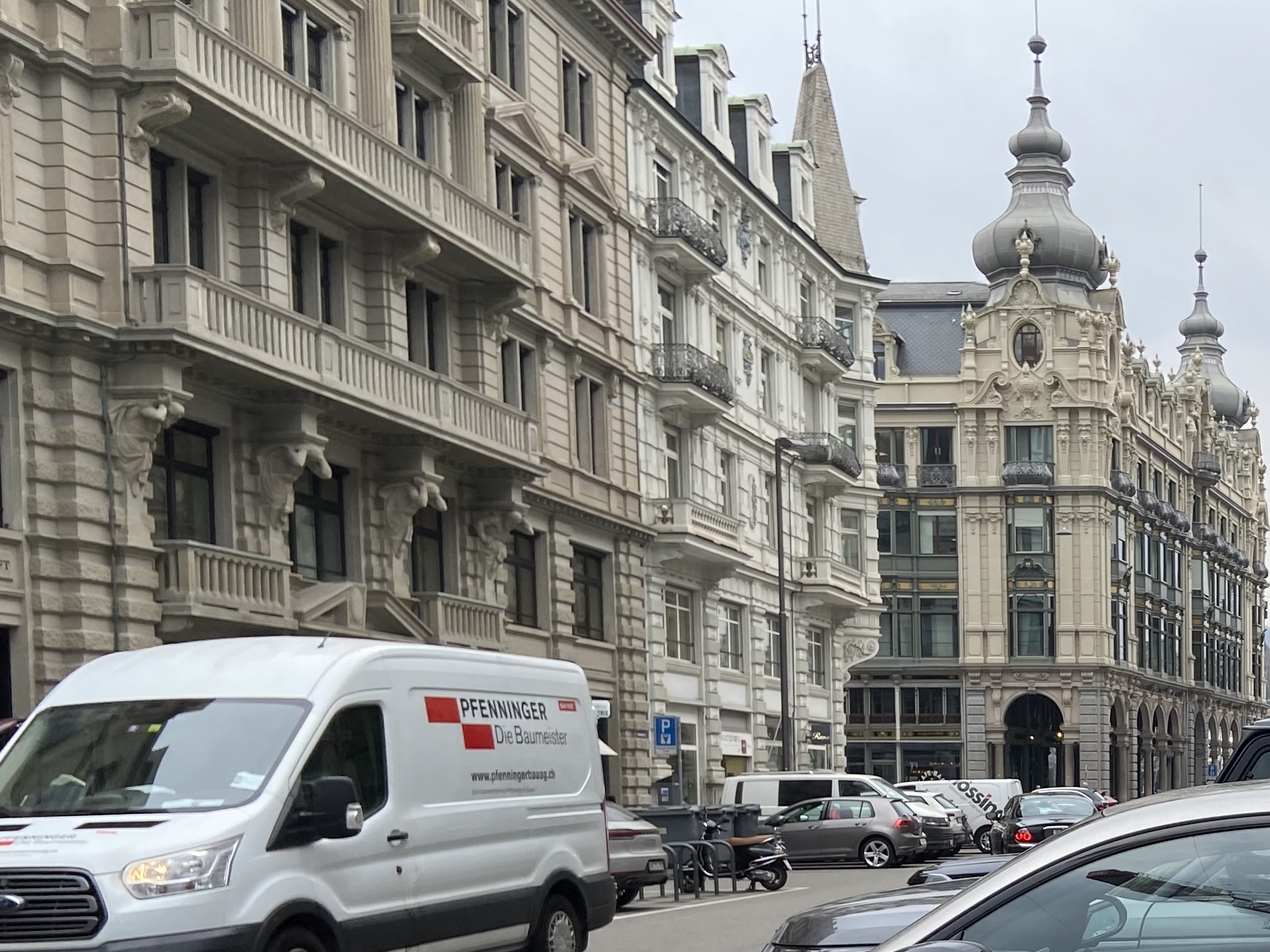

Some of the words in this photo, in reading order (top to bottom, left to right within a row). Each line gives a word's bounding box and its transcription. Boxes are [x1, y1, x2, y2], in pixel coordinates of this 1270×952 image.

[460, 698, 548, 721] PFENNINGER
[494, 724, 514, 745] Die
[515, 724, 568, 746] Baumeister
[661, 719, 671, 733] P
[471, 769, 556, 784] www.pfenningerbauag.ch
